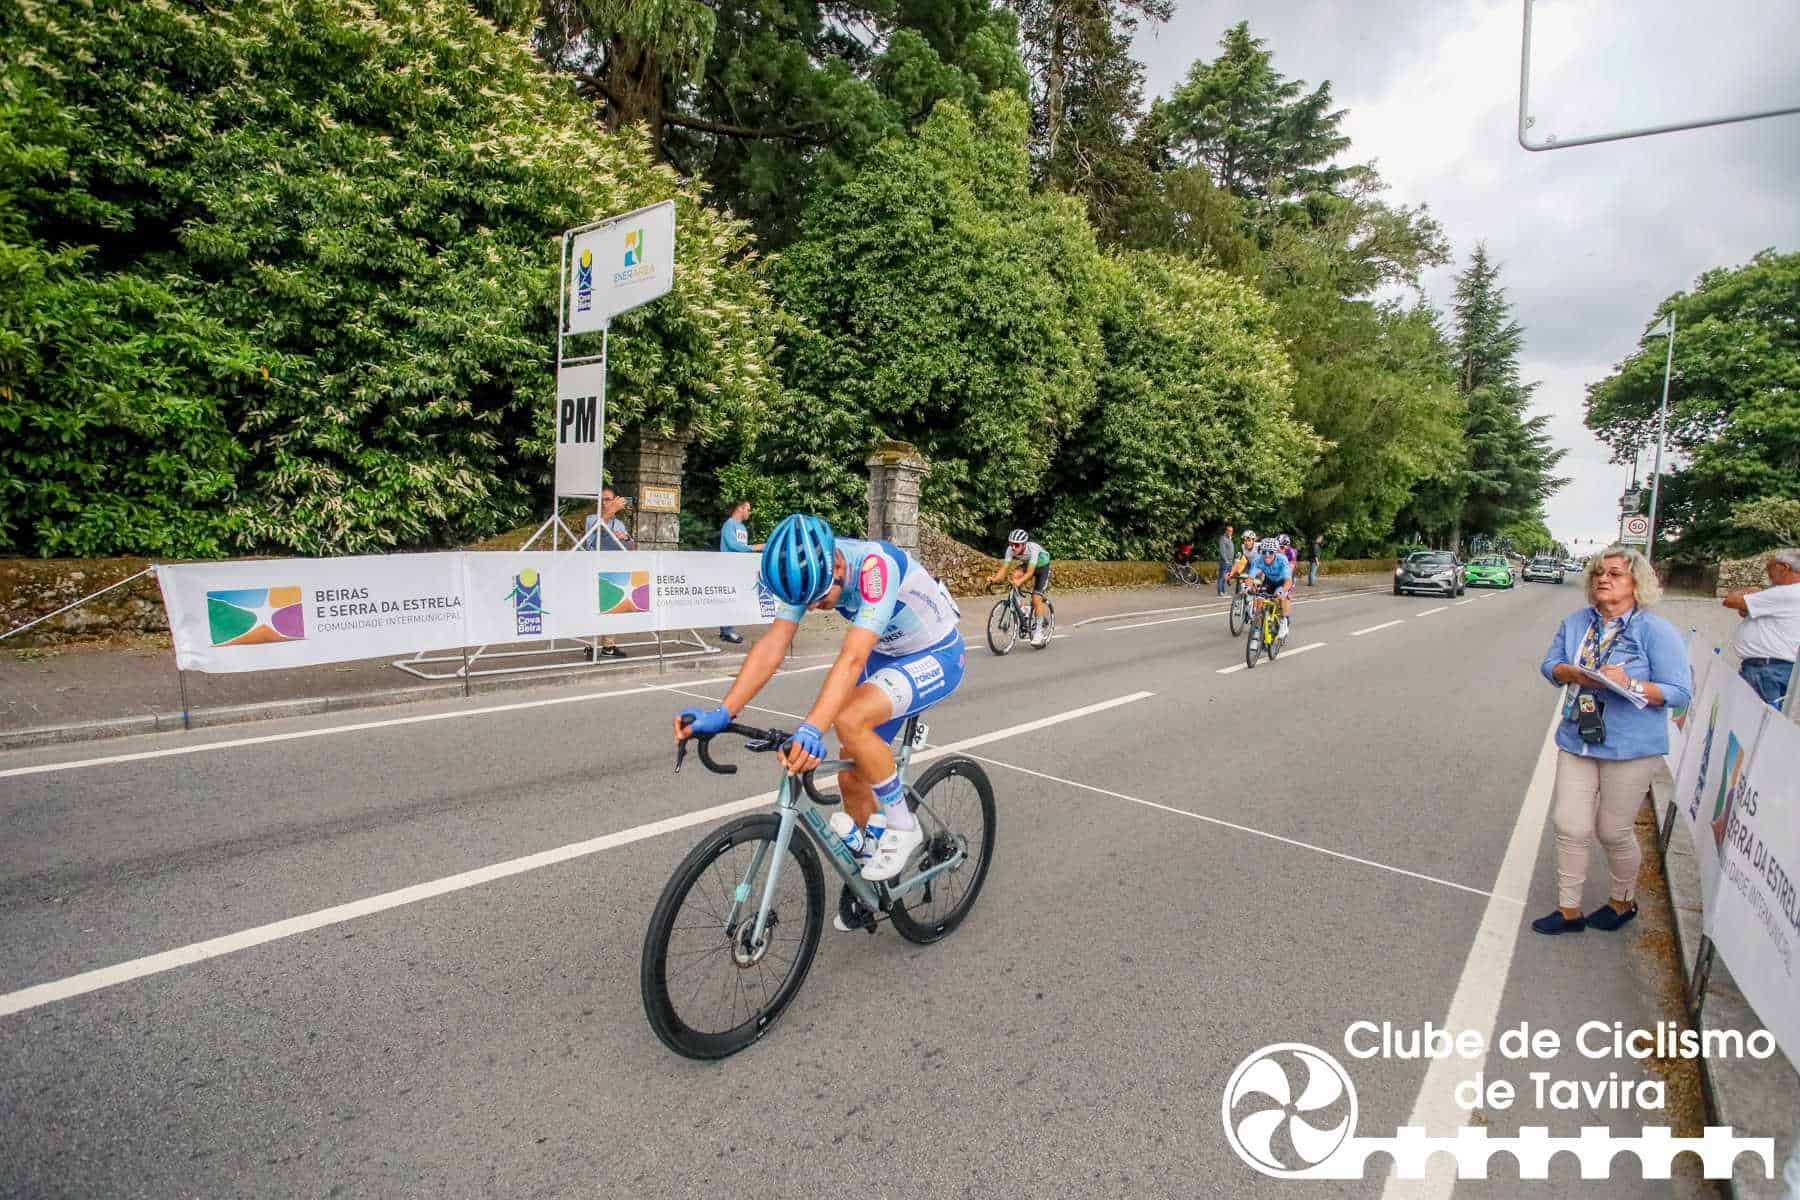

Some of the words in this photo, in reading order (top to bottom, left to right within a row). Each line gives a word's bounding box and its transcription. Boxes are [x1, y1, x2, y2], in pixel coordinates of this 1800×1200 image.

[560, 396, 597, 443] PM
[656, 575, 686, 585] BEIRAS
[315, 587, 369, 603] BEIRAS
[657, 587, 663, 597] E
[664, 586, 690, 596] SERRA
[691, 586, 703, 596] DA
[704, 585, 737, 595] ESTRELA
[317, 606, 326, 618] E
[329, 602, 378, 617] SERRA
[381, 601, 400, 613] DA
[403, 596, 461, 611] ESTRELA
[317, 619, 382, 633] COMUNIDADE
[1753, 839, 1768, 879] DA
